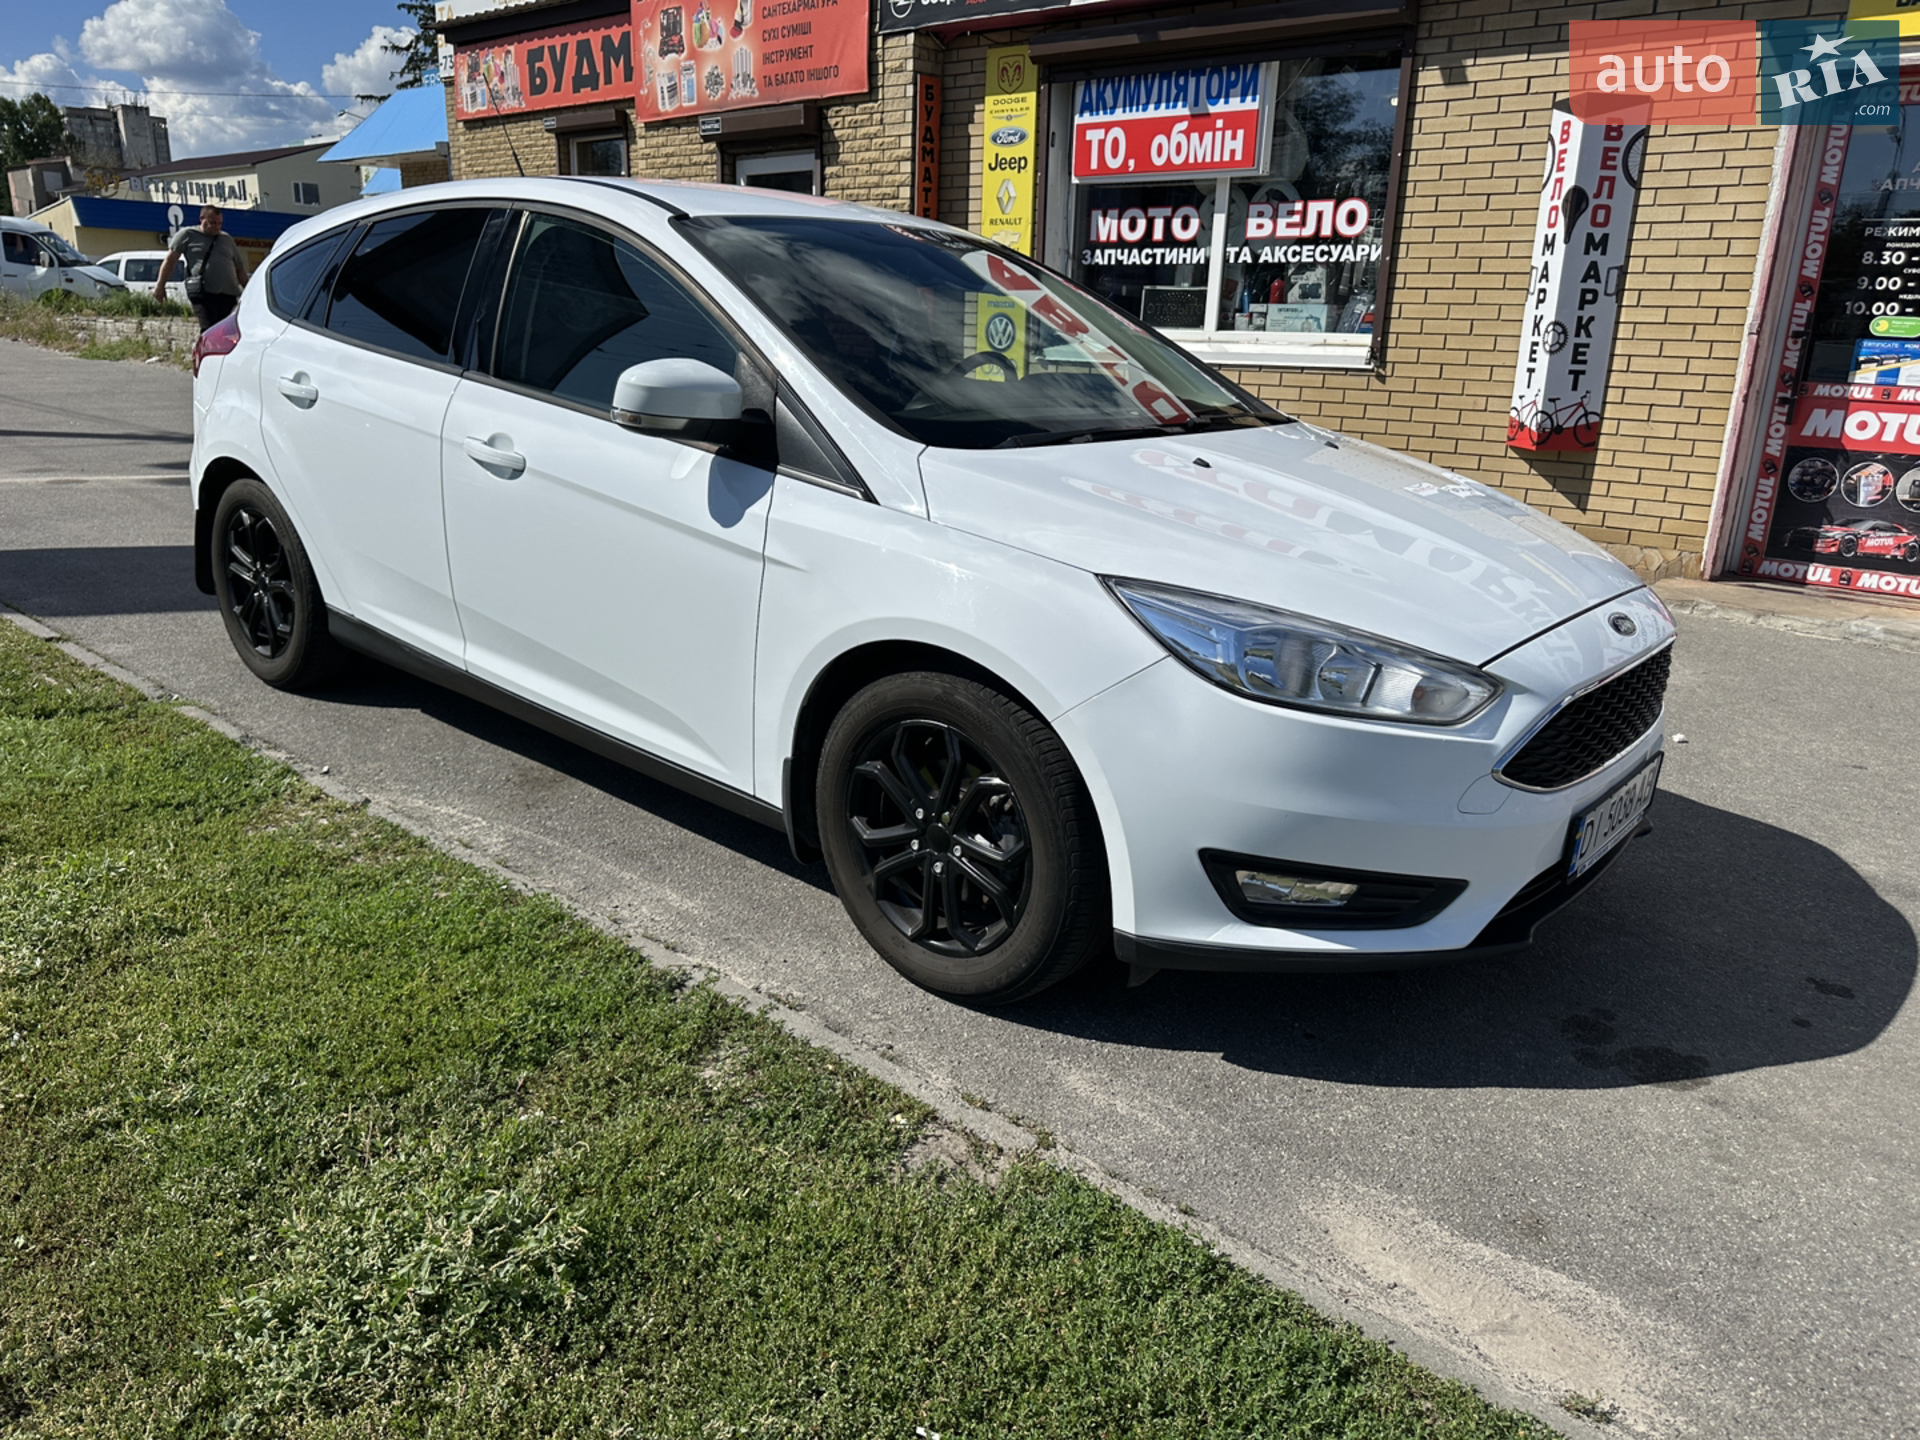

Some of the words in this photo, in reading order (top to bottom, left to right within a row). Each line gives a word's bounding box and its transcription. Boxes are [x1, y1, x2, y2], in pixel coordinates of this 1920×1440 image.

[762, 29, 779, 42] СУХІ
[781, 22, 812, 40] СУМІШІ
[526, 30, 634, 96] БУДМ
[762, 45, 814, 65] ІНСТРУМЕНТ
[763, 75, 773, 88] ТА
[775, 70, 805, 86] БАГАТО
[807, 65, 839, 81] ІНШОГО
[993, 97, 1027, 106] DODGE
[1079, 63, 1260, 118] АКУМУЛЯТОРИ
[996, 129, 1021, 144] Ford
[1085, 126, 1136, 172] ТО,
[1150, 118, 1245, 166] обмін
[988, 153, 1028, 174] Jeep
[989, 217, 1023, 226] RENAULT
[1090, 205, 1200, 243] МОТО
[1245, 197, 1369, 239] ВЕЛО
[1082, 247, 1205, 266] ЗАПЧАСТИНИ
[1227, 246, 1252, 264] ТА
[1258, 243, 1383, 264] АКСЕСУАРИ
[1526, 120, 1572, 389] ВЕЛОМАРКЕТ
[1568, 117, 1624, 391] ВЕЛОМАРКЕТ
[1801, 207, 1831, 279] MOTUL
[1862, 251, 1906, 265] 8.30
[1857, 276, 1902, 290] 9.00
[1845, 301, 1900, 316] 10.00
[1813, 385, 1874, 399] MOTUL
[1800, 408, 1920, 445] MOTU
[1748, 476, 1775, 541] MOTUL
[1757, 560, 1833, 583] MOTUL
[1856, 572, 1920, 595] MOTU
